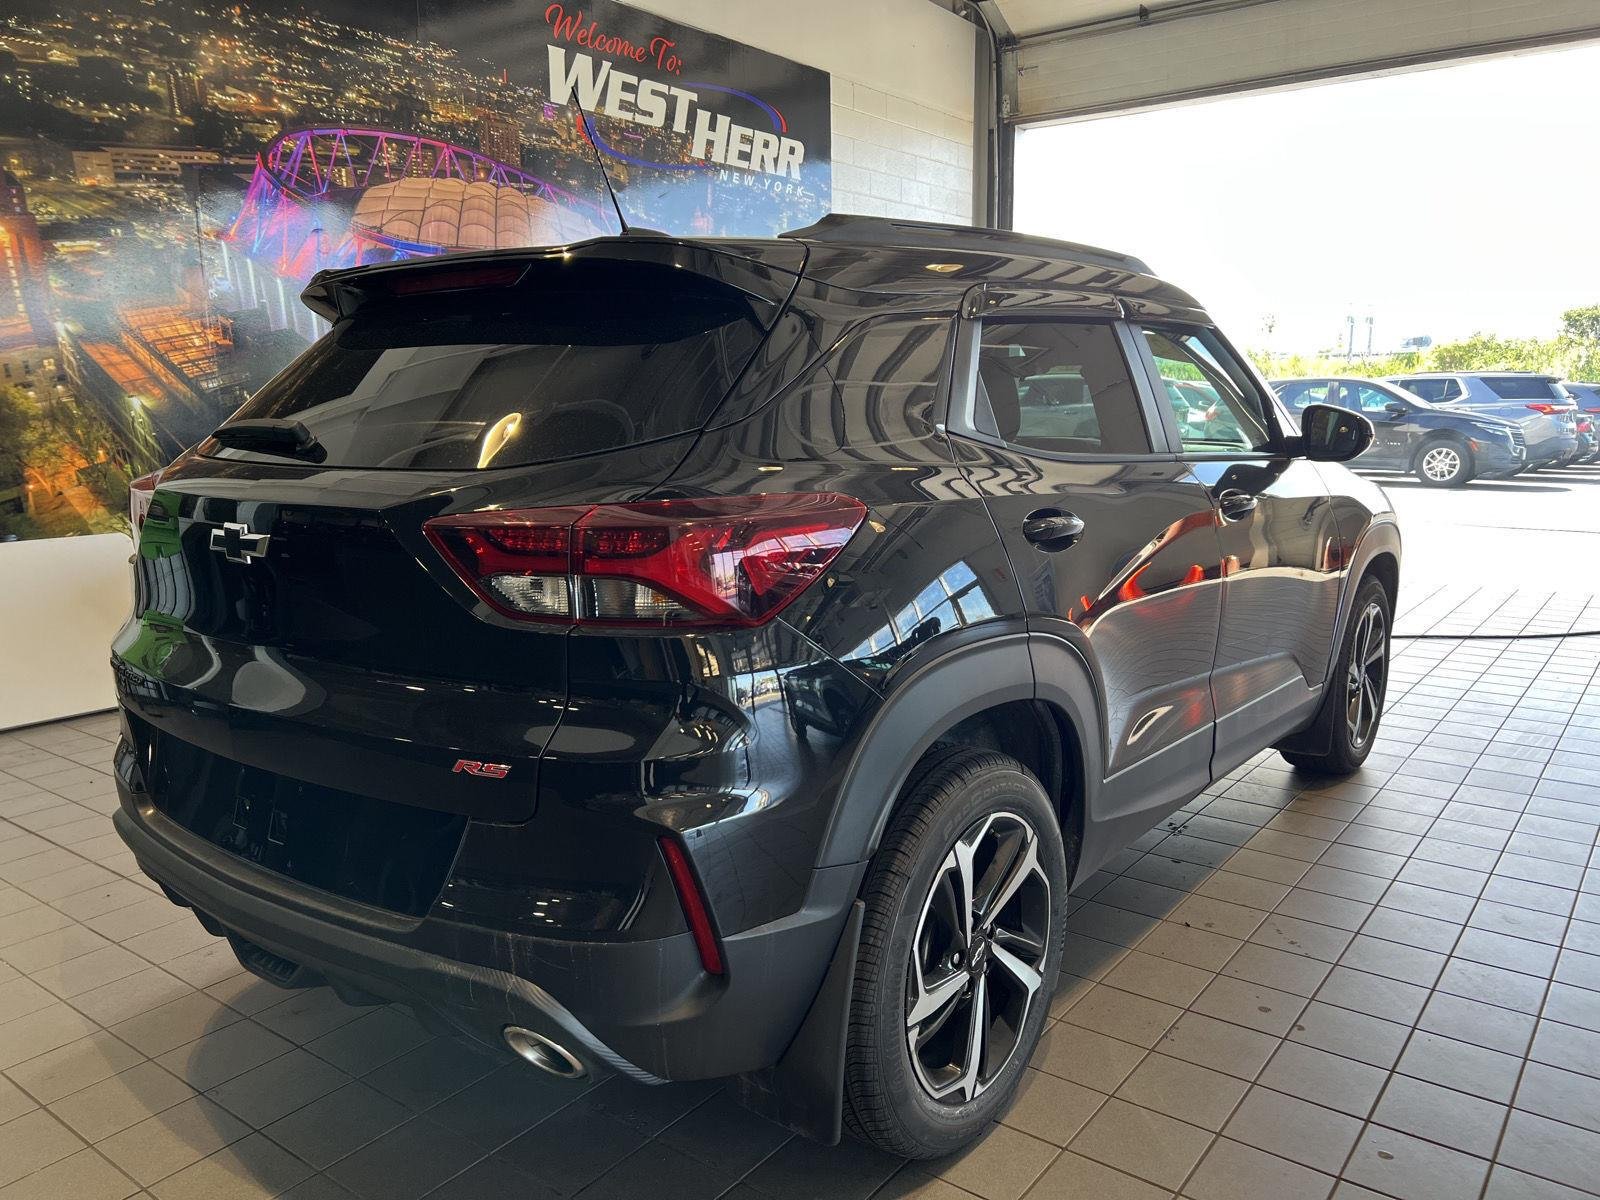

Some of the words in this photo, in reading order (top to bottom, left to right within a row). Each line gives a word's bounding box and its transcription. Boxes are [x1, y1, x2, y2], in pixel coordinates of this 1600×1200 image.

[545, 4, 648, 63] Welcome
[650, 36, 683, 76] To:
[547, 44, 698, 134] WEST
[691, 108, 805, 180] HERR
[719, 169, 755, 187] NEW
[764, 178, 804, 197] YORK
[452, 759, 512, 778] RS
